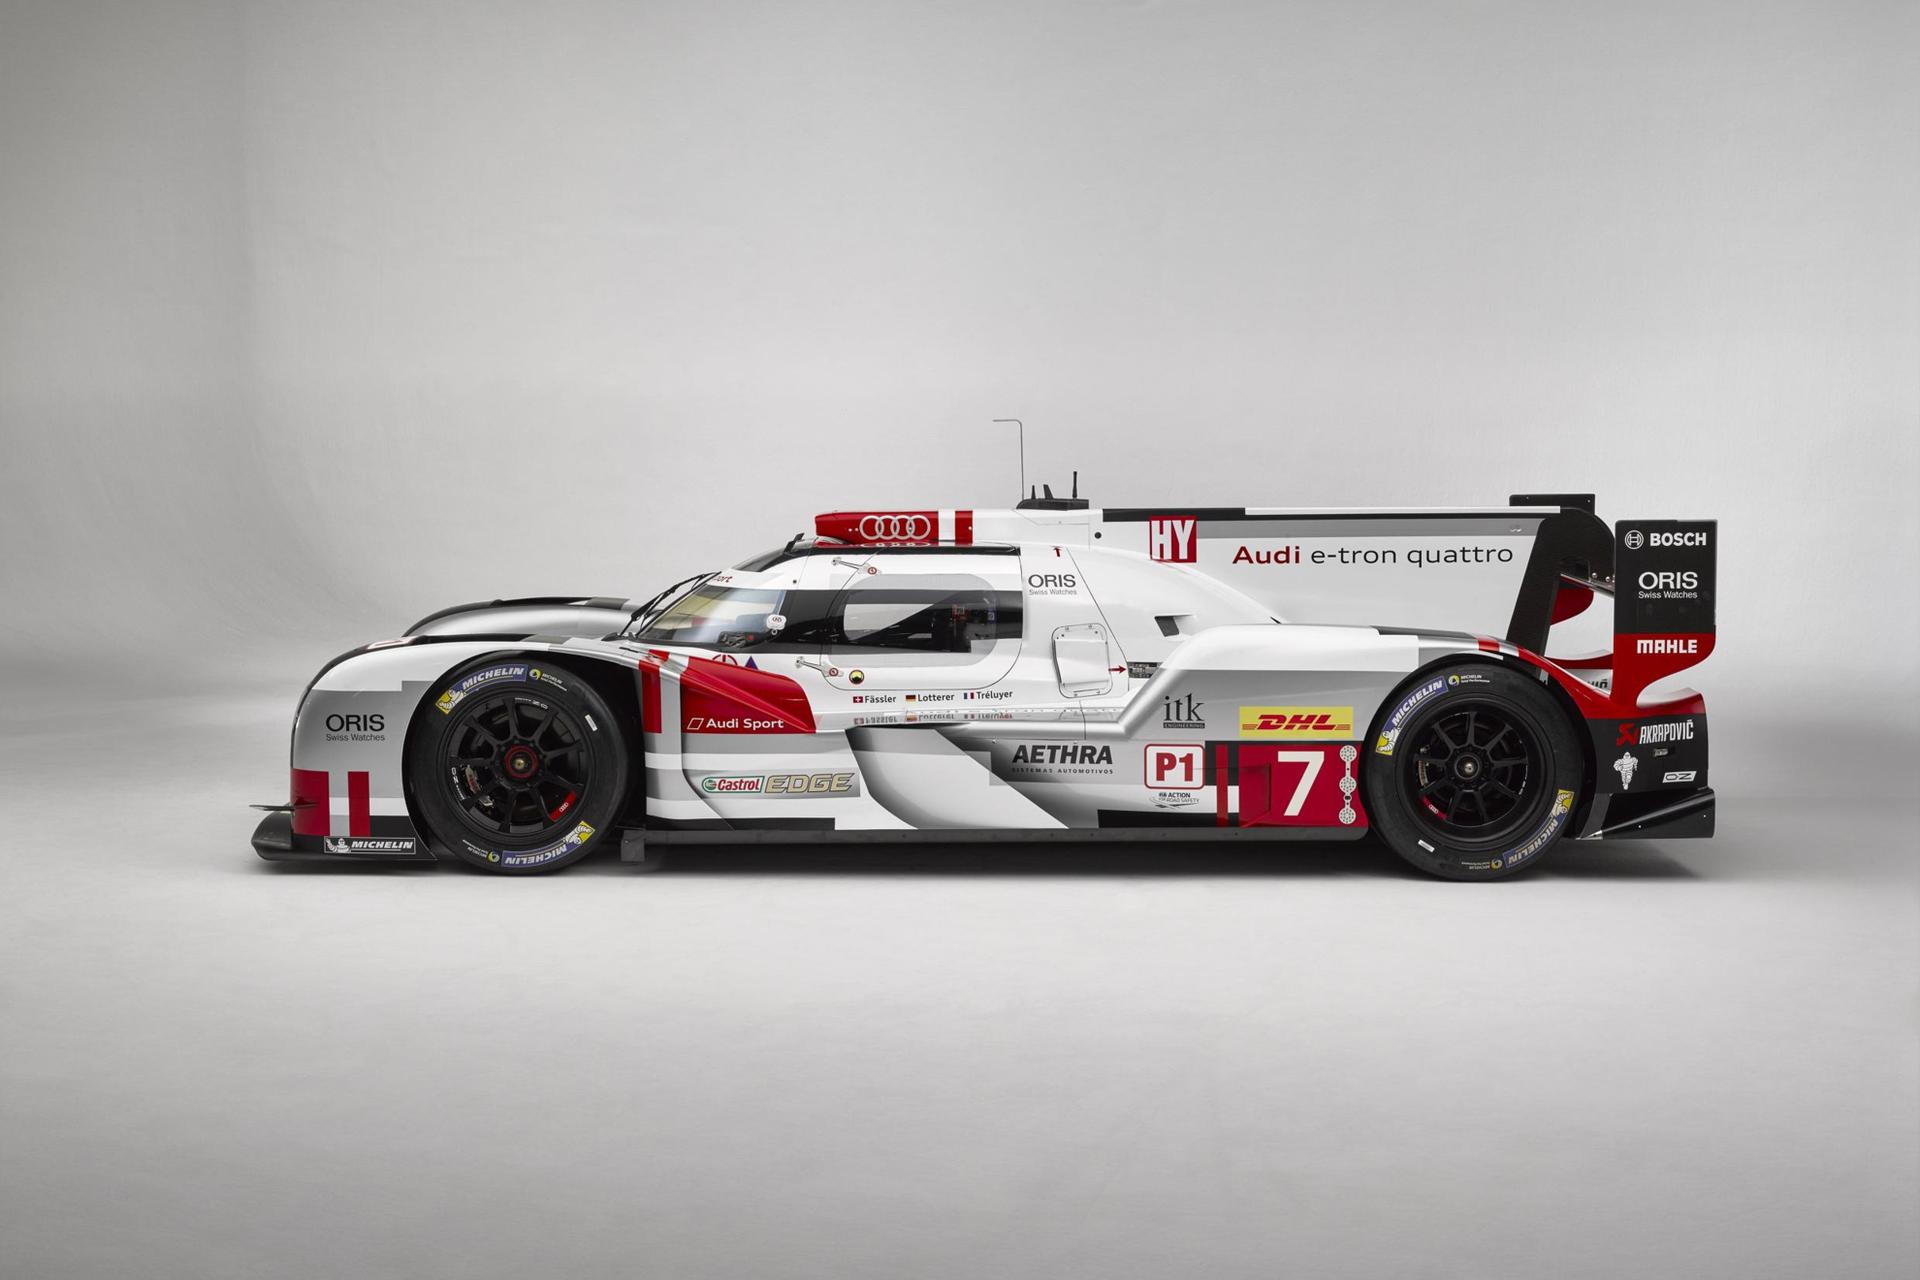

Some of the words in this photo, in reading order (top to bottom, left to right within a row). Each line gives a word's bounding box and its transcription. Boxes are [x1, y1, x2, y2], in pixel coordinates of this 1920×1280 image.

[1151, 519, 1195, 560] HY
[1650, 532, 1707, 546] BOSCH
[1232, 546, 1300, 564] Audi
[1311, 547, 1397, 564] e-tron
[1407, 547, 1513, 568] quattro
[1028, 574, 1076, 588] ORIS
[1639, 572, 1698, 589] ORIS
[1637, 639, 1697, 654] MAHLE
[462, 667, 525, 690] MICHELIN
[865, 695, 896, 704] Fässler
[918, 694, 955, 702] Lotterer
[976, 691, 1013, 701] Tréluyer
[1163, 692, 1205, 721] itk
[1391, 680, 1443, 726] MICHELIN
[326, 714, 385, 732] ORIS
[706, 719, 739, 729] Audi
[743, 719, 784, 731] Sport
[1257, 714, 1337, 731] DHL
[1639, 719, 1694, 744] AKRAPOVIČ
[351, 733, 385, 741] Watches
[1012, 745, 1113, 765] AETHRA
[1156, 752, 1193, 782] P1
[718, 778, 761, 791] Castrol
[765, 773, 855, 794] EDGE
[1278, 751, 1325, 816] 7
[351, 841, 413, 849] MICHELIN
[1508, 818, 1559, 865] MICHELIN
[504, 843, 568, 865] MICHELIN
